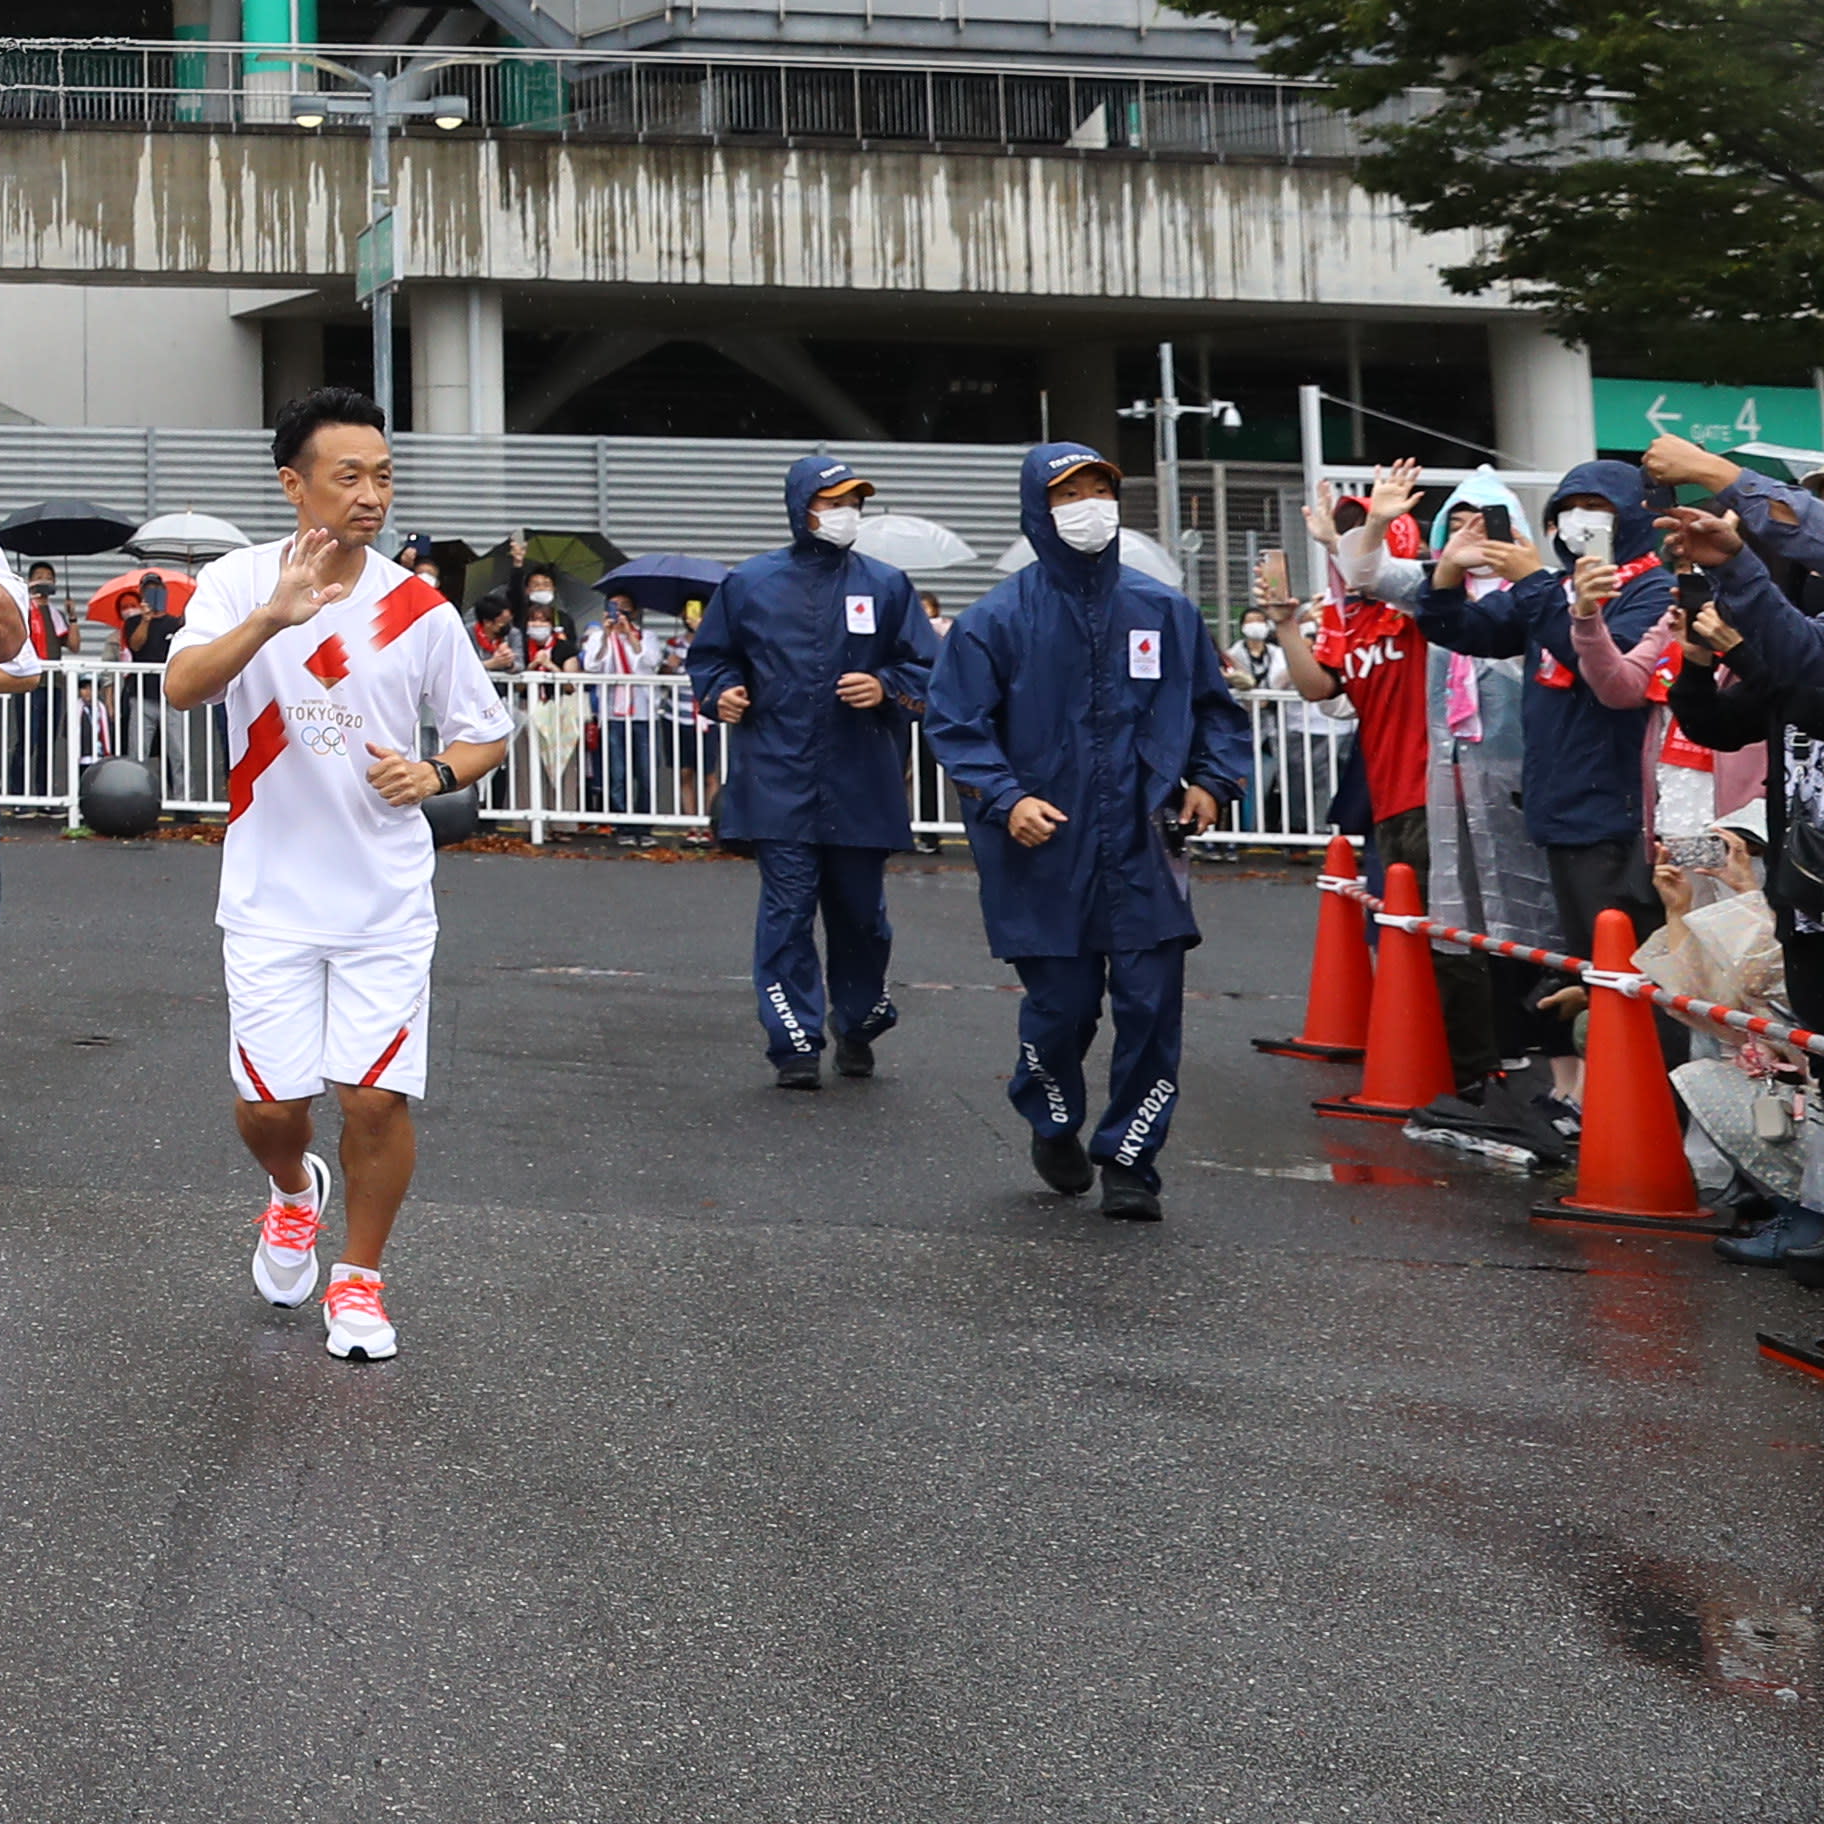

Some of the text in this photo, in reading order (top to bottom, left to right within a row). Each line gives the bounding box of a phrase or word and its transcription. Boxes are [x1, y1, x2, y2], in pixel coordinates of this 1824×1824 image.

[1735, 397, 1762, 441] 4
[766, 982, 799, 1029] TOKYO
[1137, 1079, 1175, 1123] 2020
